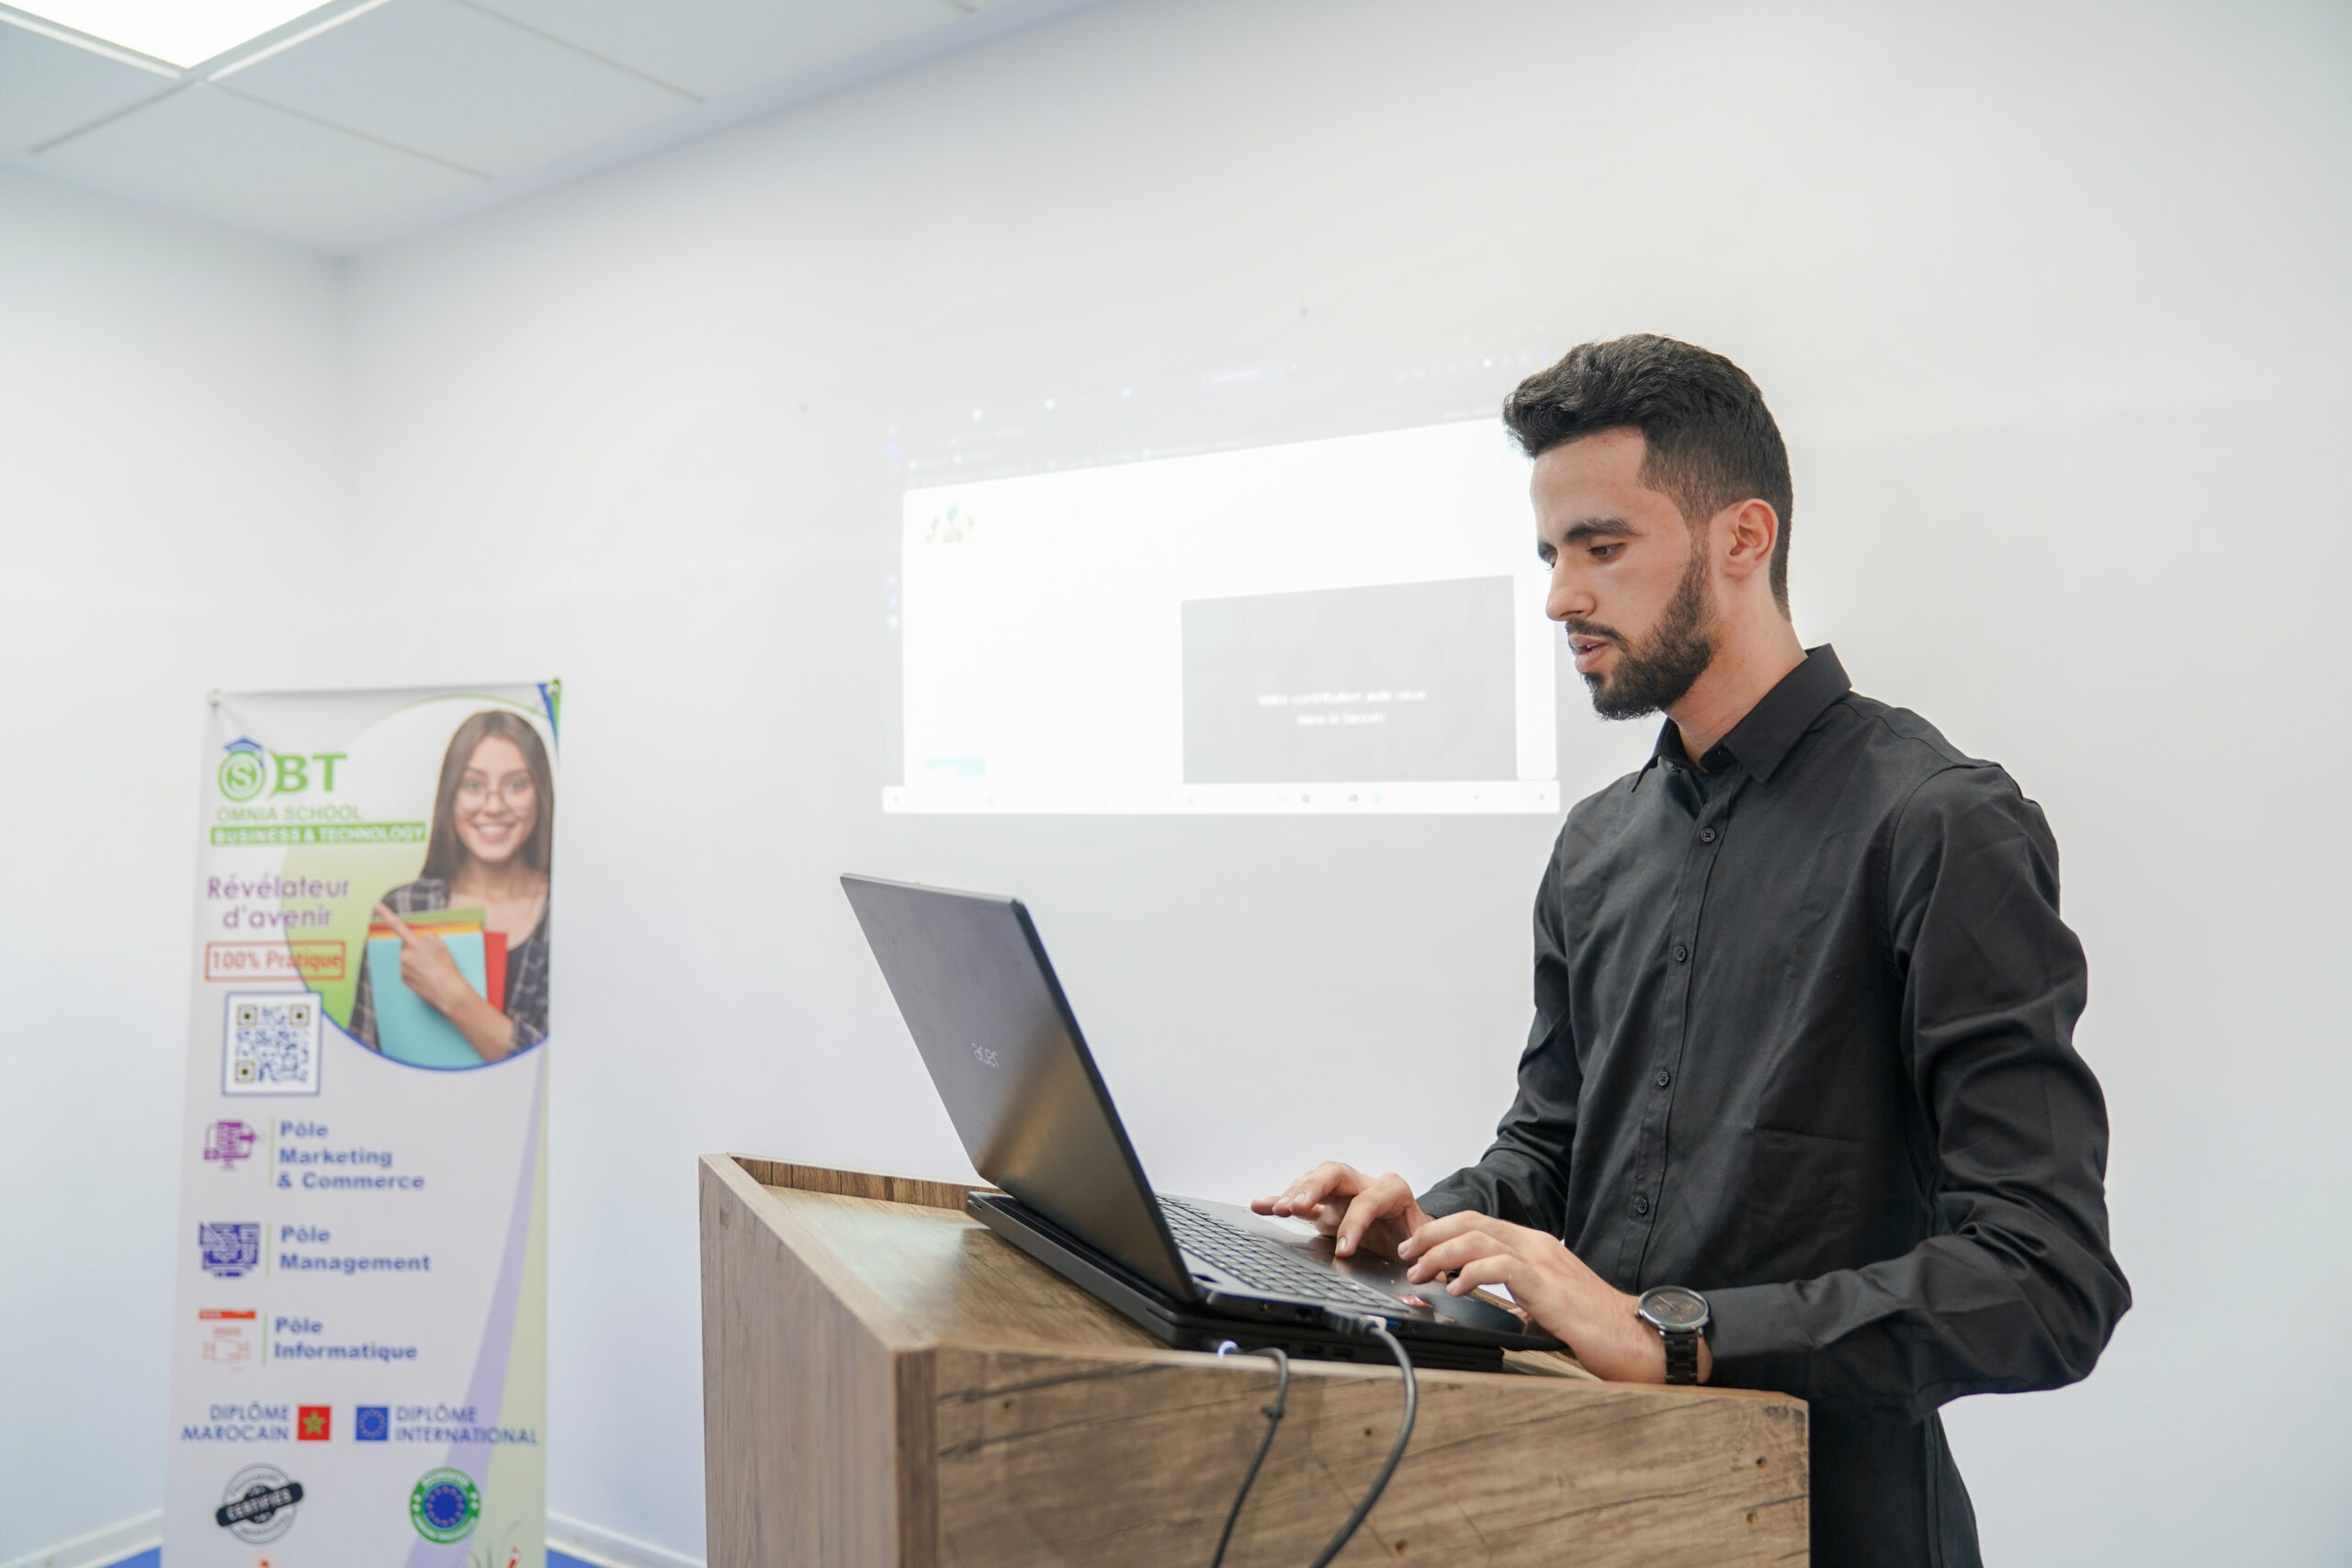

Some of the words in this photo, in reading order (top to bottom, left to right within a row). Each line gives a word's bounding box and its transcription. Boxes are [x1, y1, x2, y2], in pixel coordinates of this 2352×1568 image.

[216, 806, 279, 823] OMNIA
[284, 803, 364, 822] SCHOOL
[214, 827, 300, 844] BUSINESS
[303, 827, 315, 842] &
[320, 824, 426, 841] TECHNOLOGY
[207, 872, 350, 898] Révélateur
[222, 903, 333, 929] d'avenir
[212, 950, 259, 969] 100%
[266, 949, 344, 973] Pratique
[279, 1119, 329, 1138] Pôle
[278, 1147, 393, 1168] Marketing
[277, 1171, 292, 1189] &
[302, 1171, 425, 1190] Commerce
[280, 1224, 332, 1243] Pôle
[279, 1252, 431, 1274] Management
[275, 1315, 323, 1334] Pôle
[275, 1340, 418, 1362] Informatique
[209, 1401, 290, 1421] DIPLÔME
[396, 1401, 477, 1423] DIPLÔME
[181, 1424, 290, 1442] MAROCAIN
[395, 1426, 538, 1444] INTERNATIONAL
